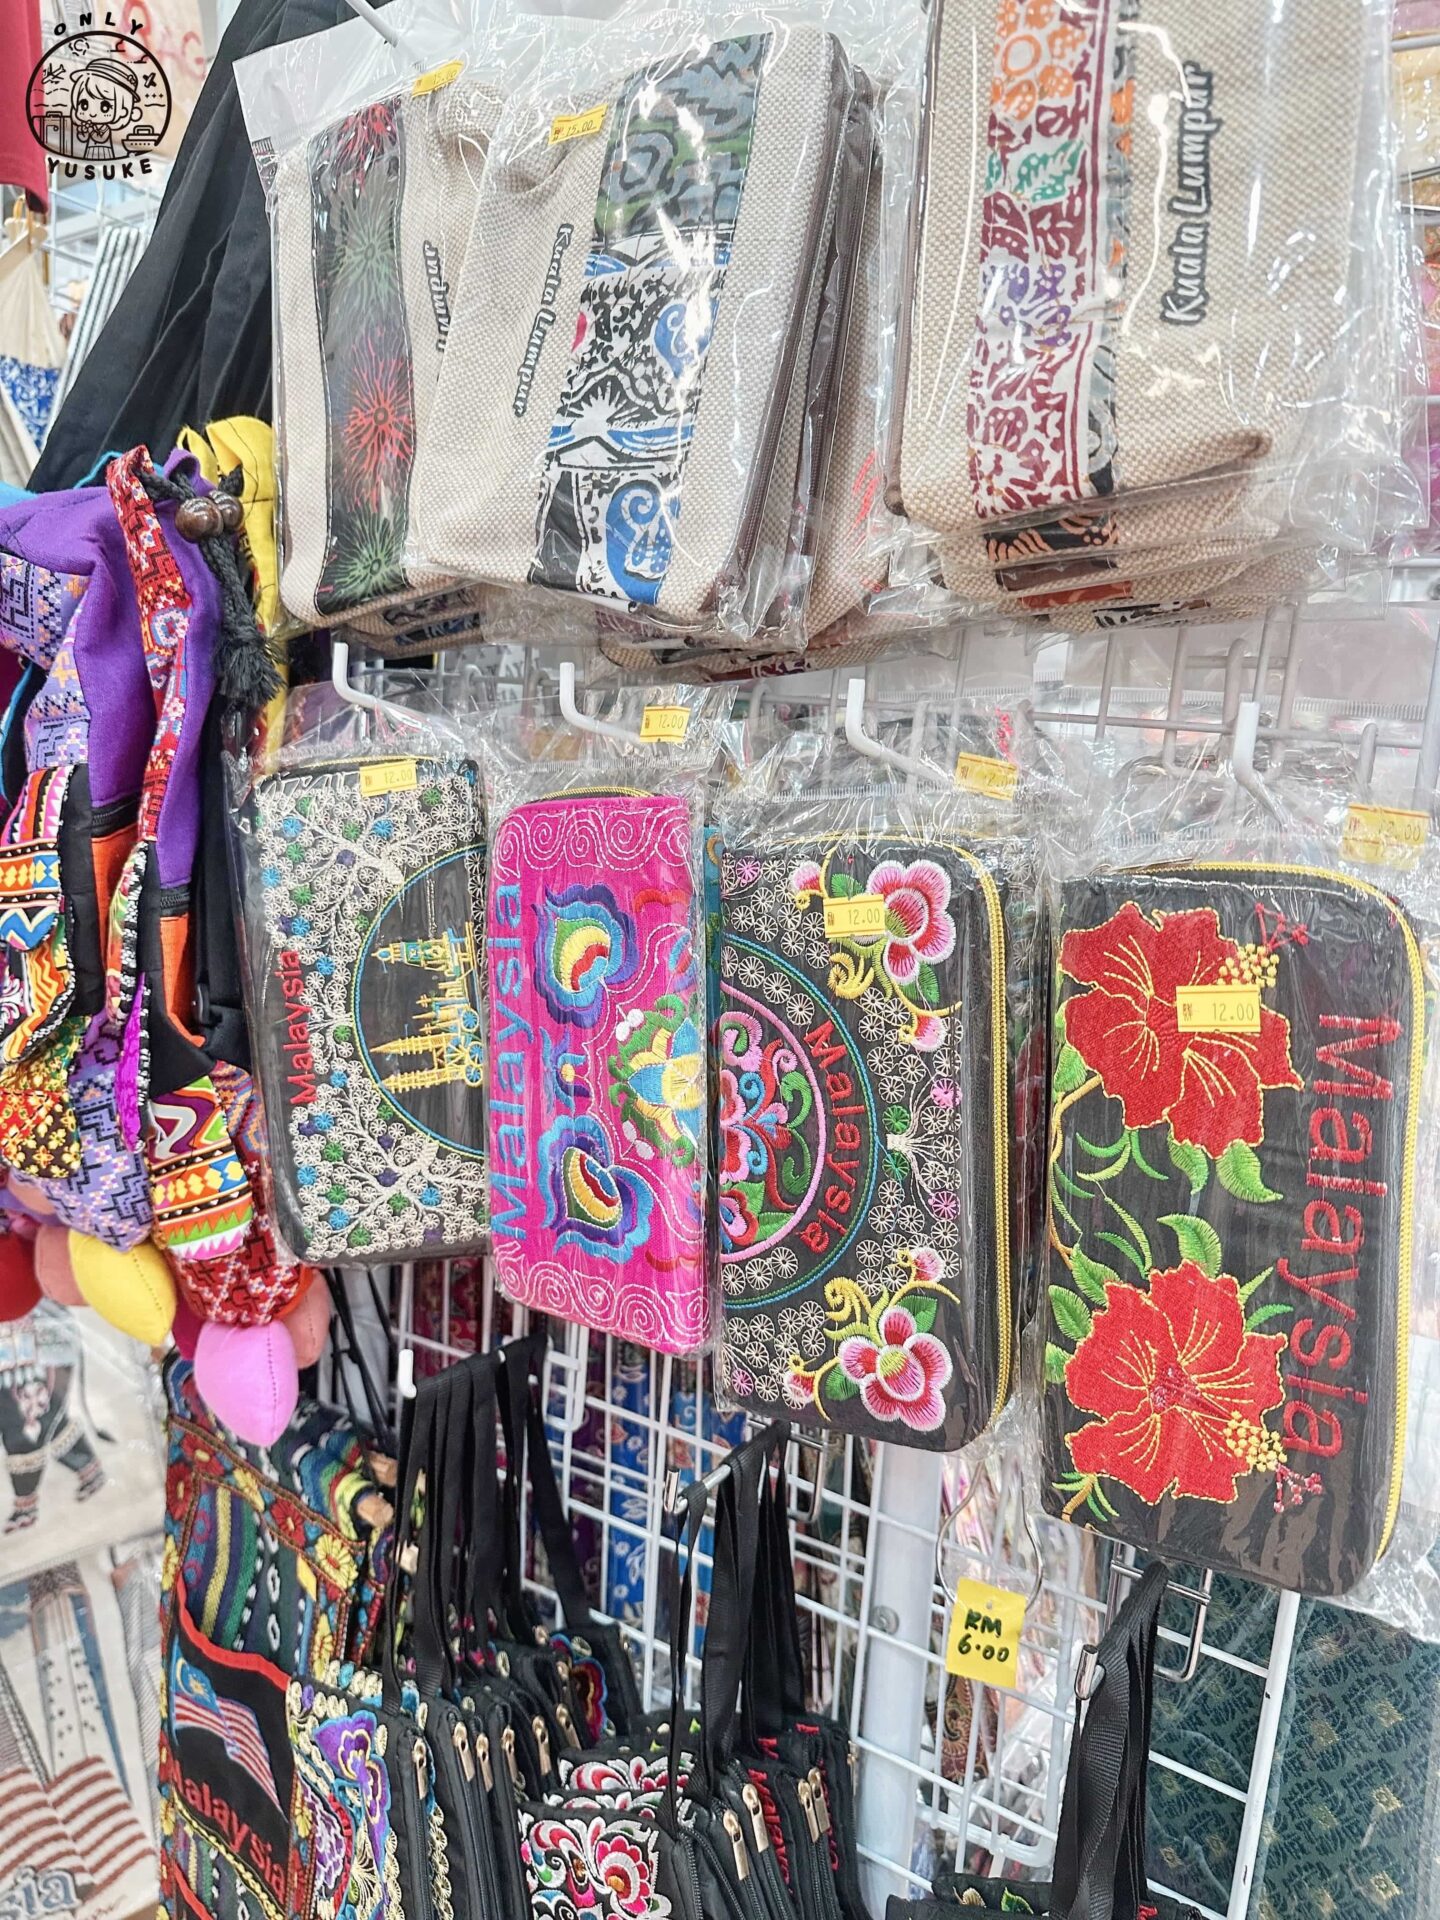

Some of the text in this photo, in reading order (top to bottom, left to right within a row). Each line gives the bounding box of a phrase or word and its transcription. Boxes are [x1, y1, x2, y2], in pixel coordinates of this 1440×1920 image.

[565, 119, 595, 137] 15.00
[1159, 60, 1224, 327] Kuala Lumpur
[512, 223, 575, 417] Kuala Lumpur
[383, 769, 414, 785] 12.00
[659, 713, 685, 729] 12.00
[848, 908, 881, 925] 12.00
[274, 951, 318, 1105] Malaysia
[487, 884, 535, 1241] Malaysia
[1213, 1002, 1255, 1022] 12.00
[801, 1019, 866, 1254] Malaysia
[1276, 1013, 1402, 1459] Malaysia
